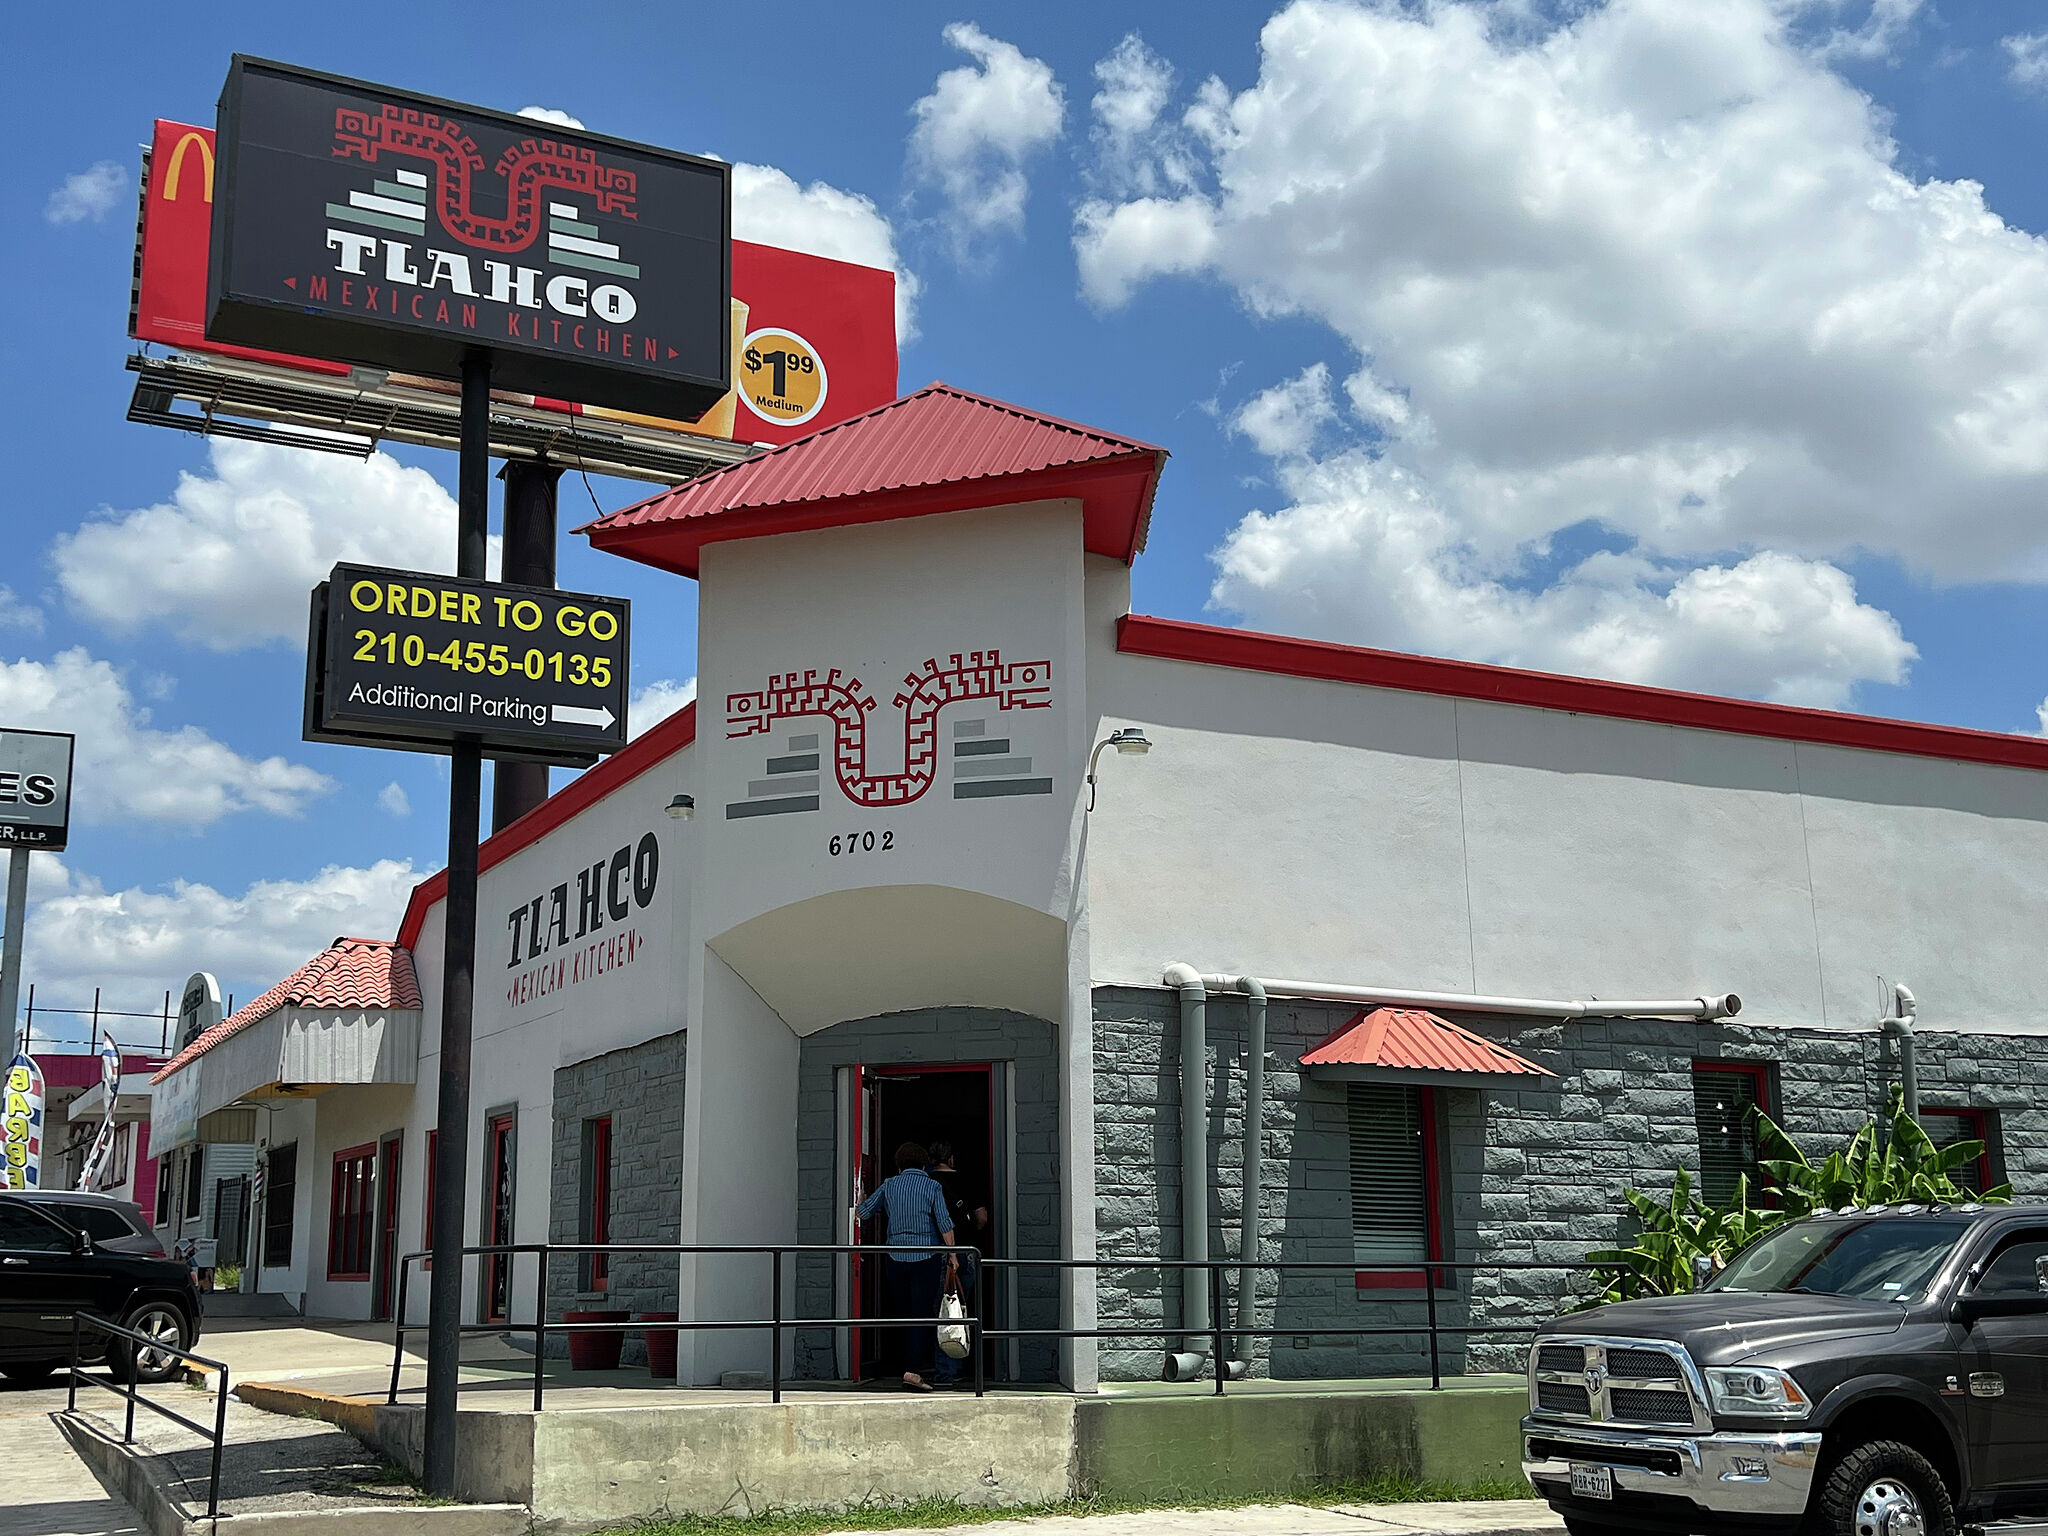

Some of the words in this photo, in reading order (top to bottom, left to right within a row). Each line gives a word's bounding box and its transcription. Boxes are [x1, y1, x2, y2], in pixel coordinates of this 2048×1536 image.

[326, 228, 637, 323] TLAHCO
[309, 275, 476, 329] MEXICAN
[508, 312, 657, 361] KITCHEN
[756, 395, 803, 413] Medium
[350, 580, 482, 625] ORDER
[493, 597, 543, 631] TO
[556, 605, 618, 641] GO
[353, 629, 611, 688] 210-455-0135
[348, 682, 463, 714] Additional
[469, 693, 547, 726] Parking
[828, 830, 895, 857] 6702
[507, 831, 659, 969] TLAHCO
[511, 957, 566, 1007] MEXICAN
[572, 928, 636, 984] KITCHEN
